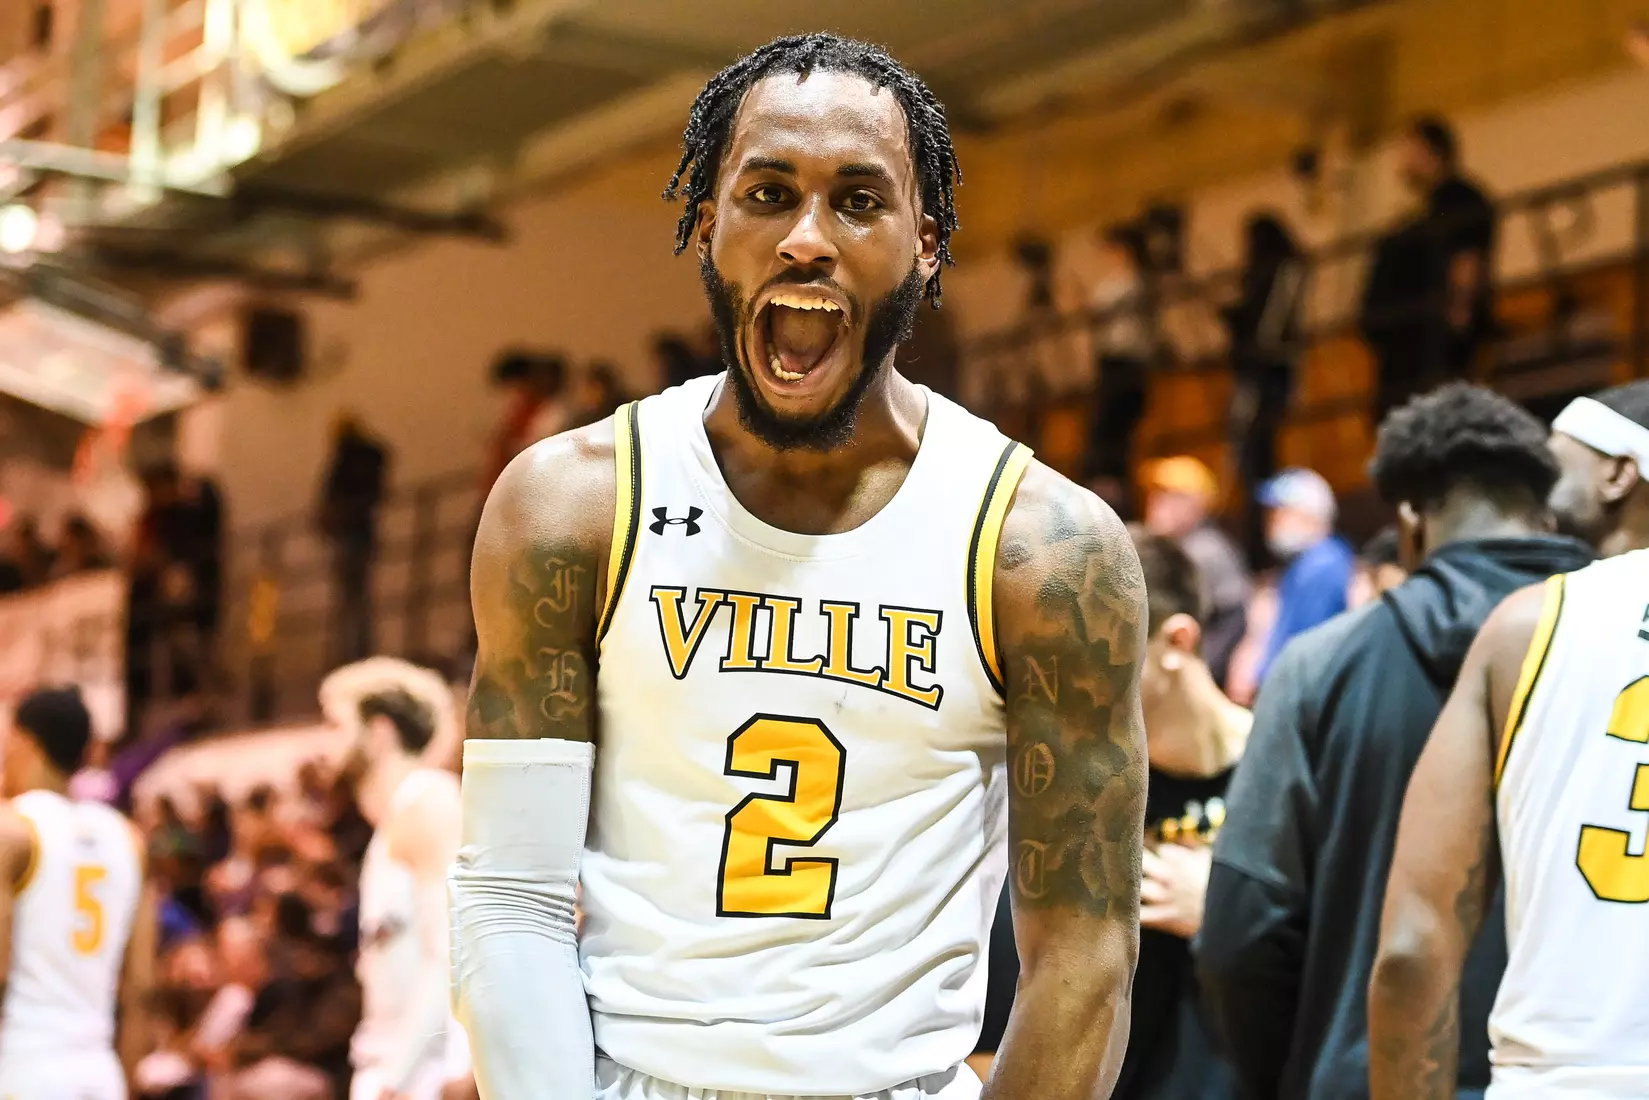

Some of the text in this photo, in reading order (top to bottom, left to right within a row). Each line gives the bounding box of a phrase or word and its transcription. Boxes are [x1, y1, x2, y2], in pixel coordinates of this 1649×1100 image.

[649, 585, 944, 711] VILLE
[716, 713, 847, 919] 2
[71, 866, 107, 956] 5
